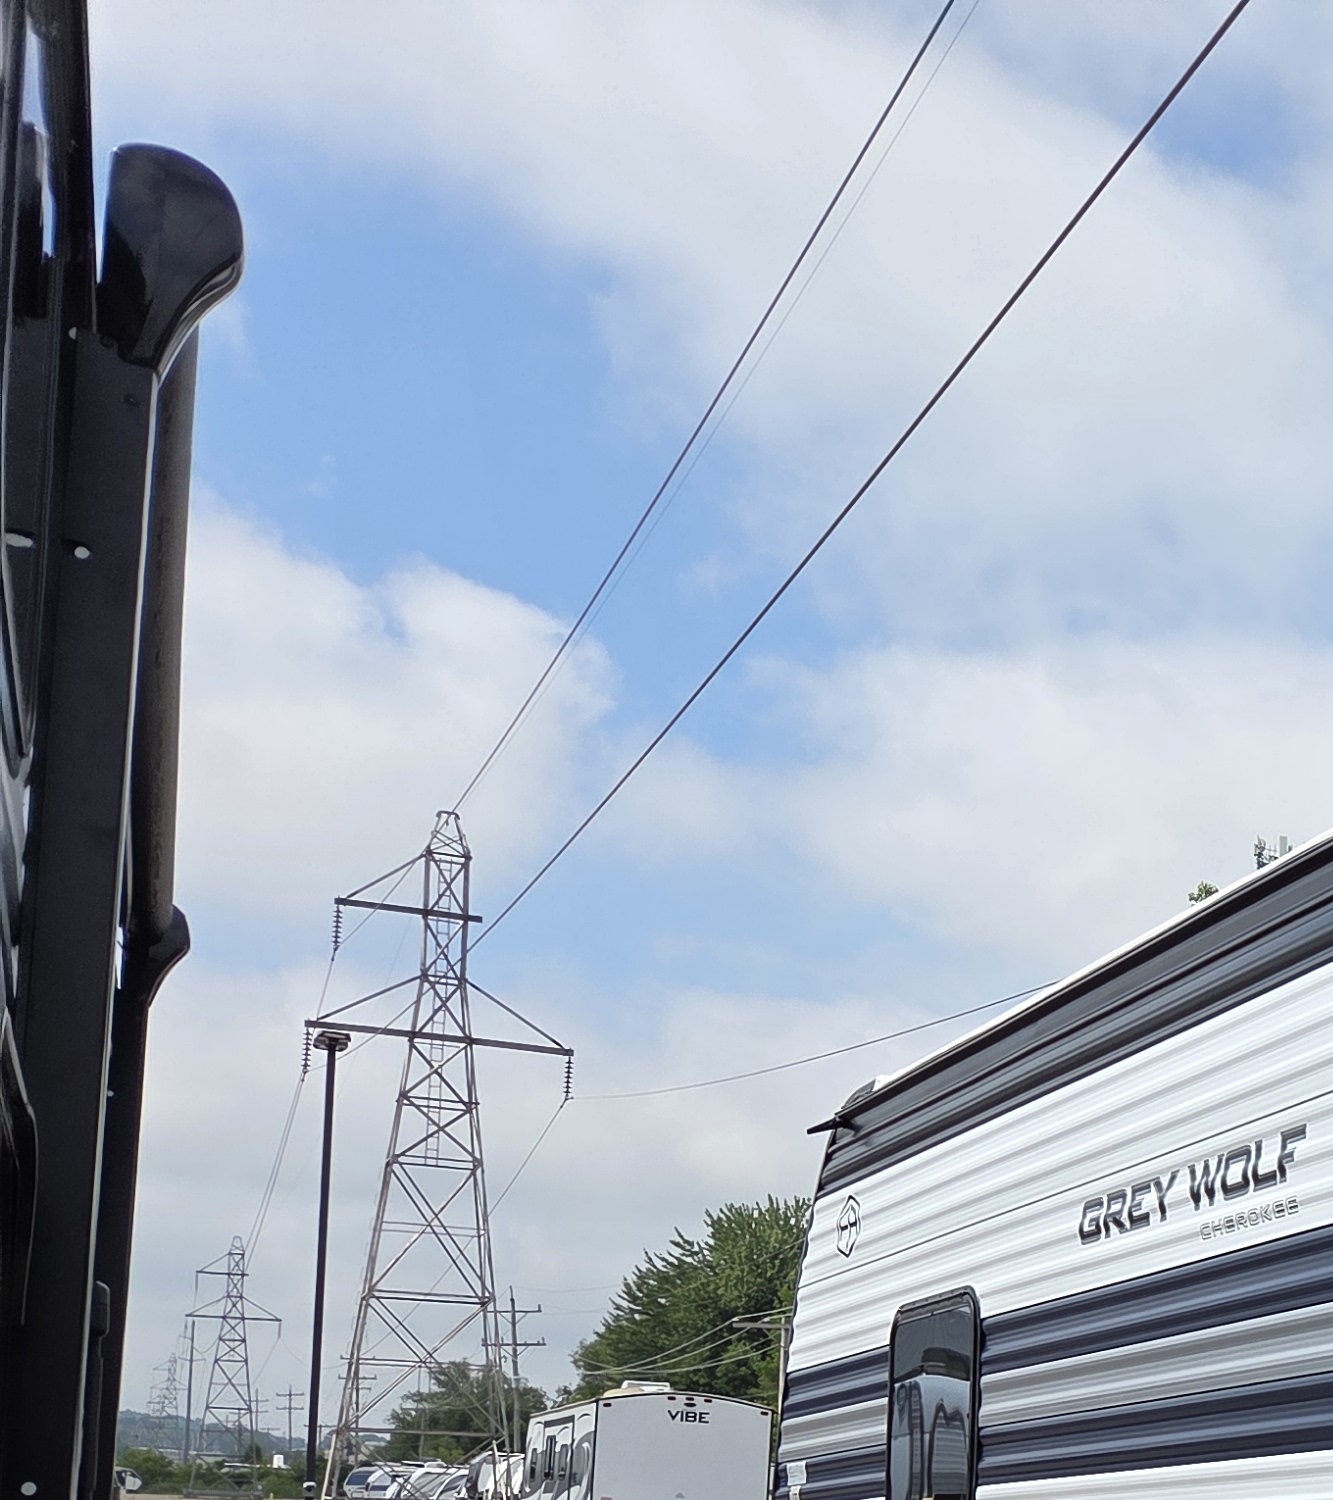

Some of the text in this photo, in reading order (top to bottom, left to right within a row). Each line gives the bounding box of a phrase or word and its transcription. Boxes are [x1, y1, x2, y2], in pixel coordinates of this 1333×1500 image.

[1078, 1123, 1307, 1245] GREY WOLF
[1200, 1196, 1299, 1240] CHEROKEE
[667, 1409, 711, 1424] VIBE
